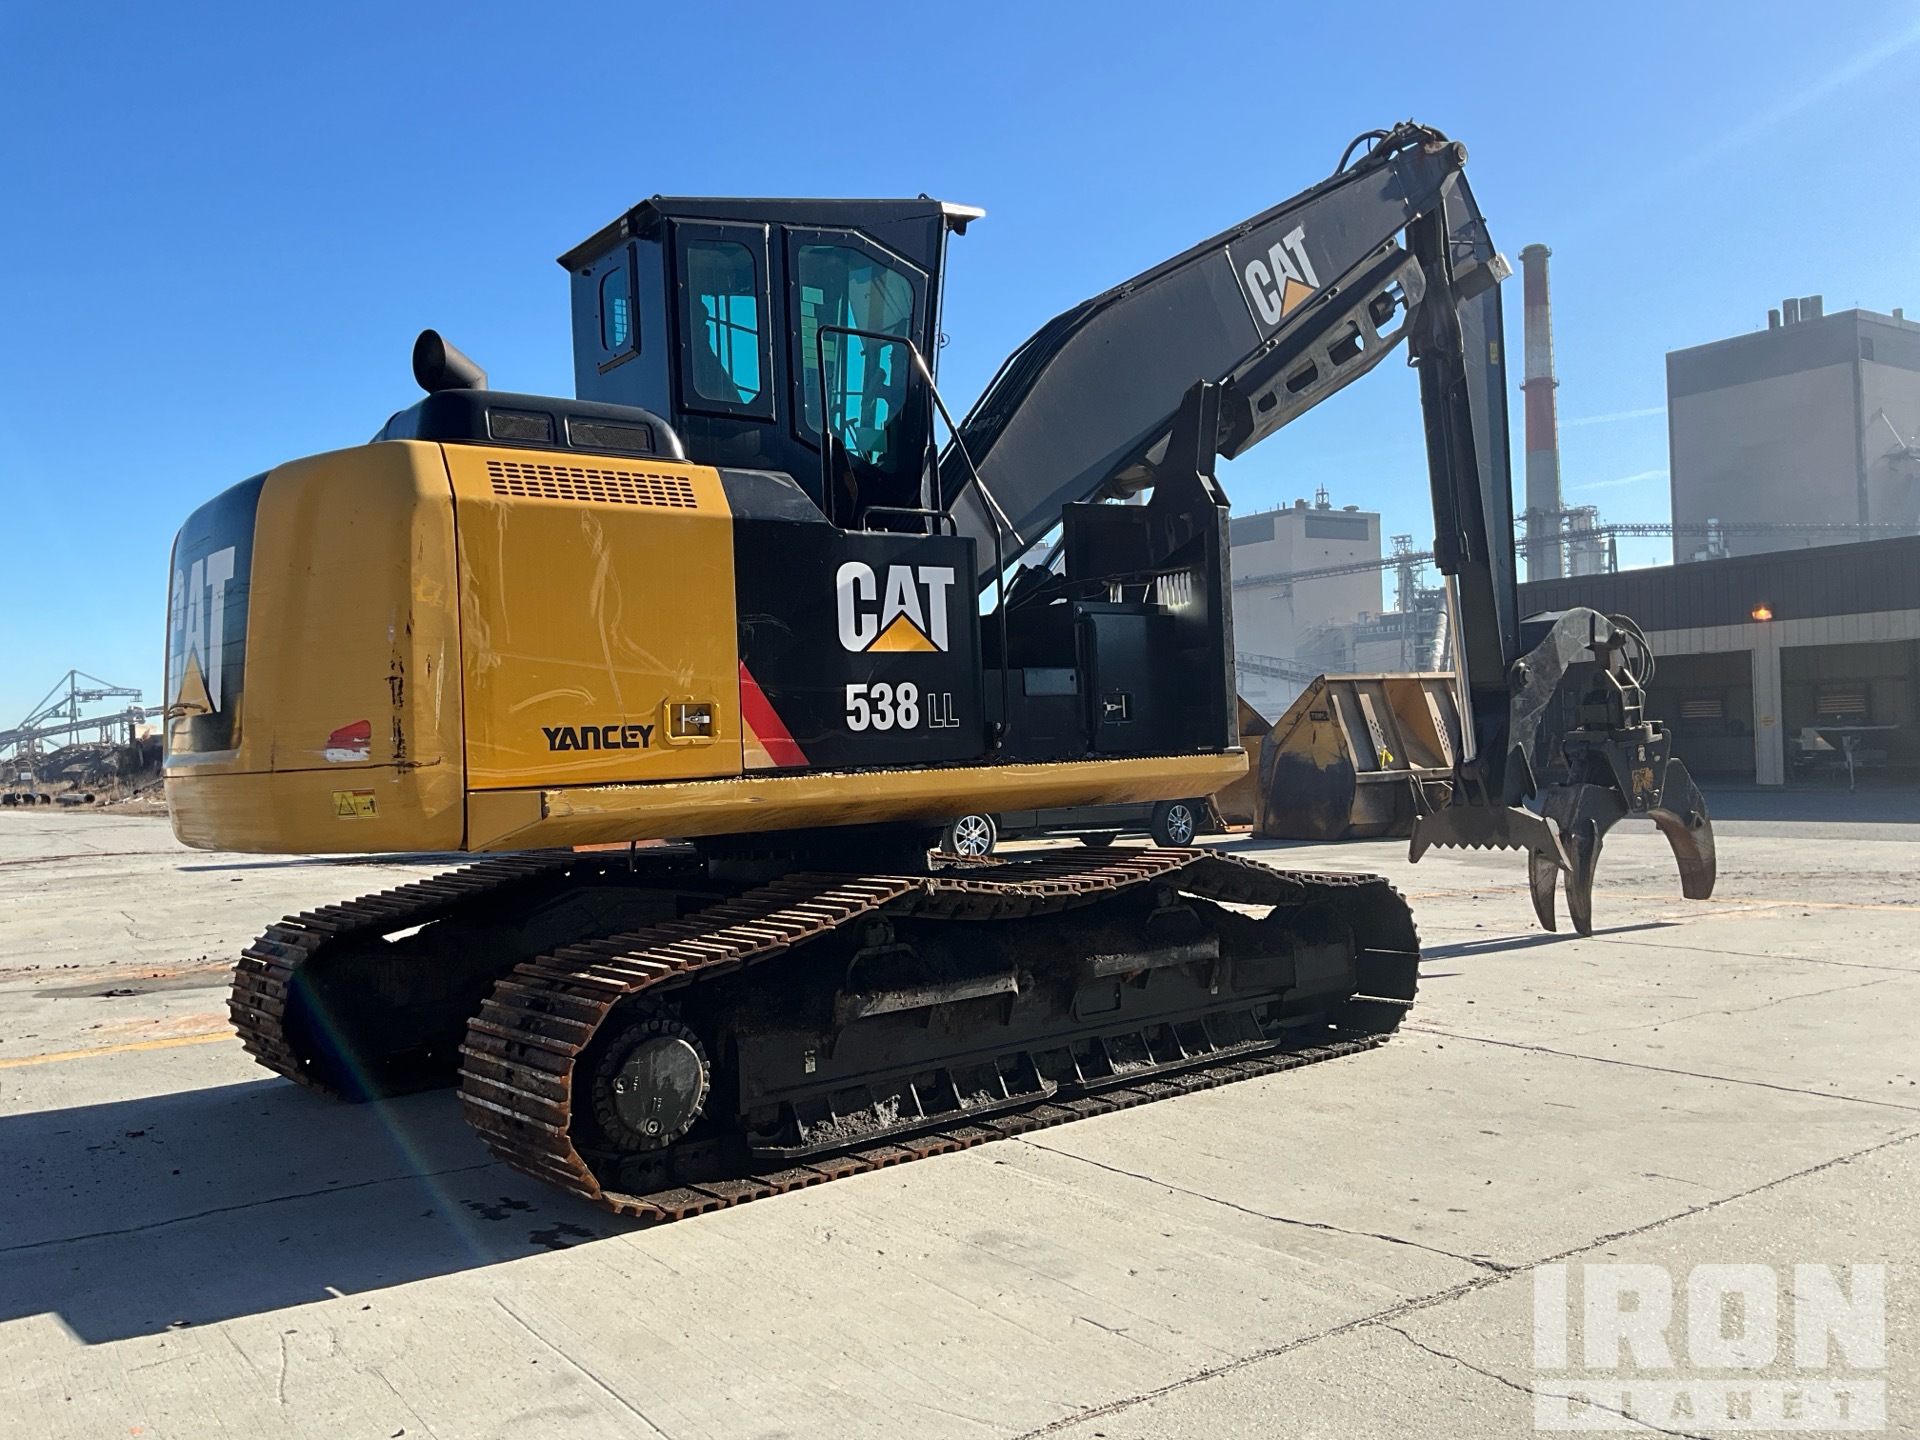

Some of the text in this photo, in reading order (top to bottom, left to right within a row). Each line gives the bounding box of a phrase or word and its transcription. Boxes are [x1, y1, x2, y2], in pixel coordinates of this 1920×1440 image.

[1245, 225, 1321, 326] CAT
[836, 561, 955, 652] CAT
[541, 724, 655, 752] YANCEY
[846, 682, 960, 732] 538 LL
